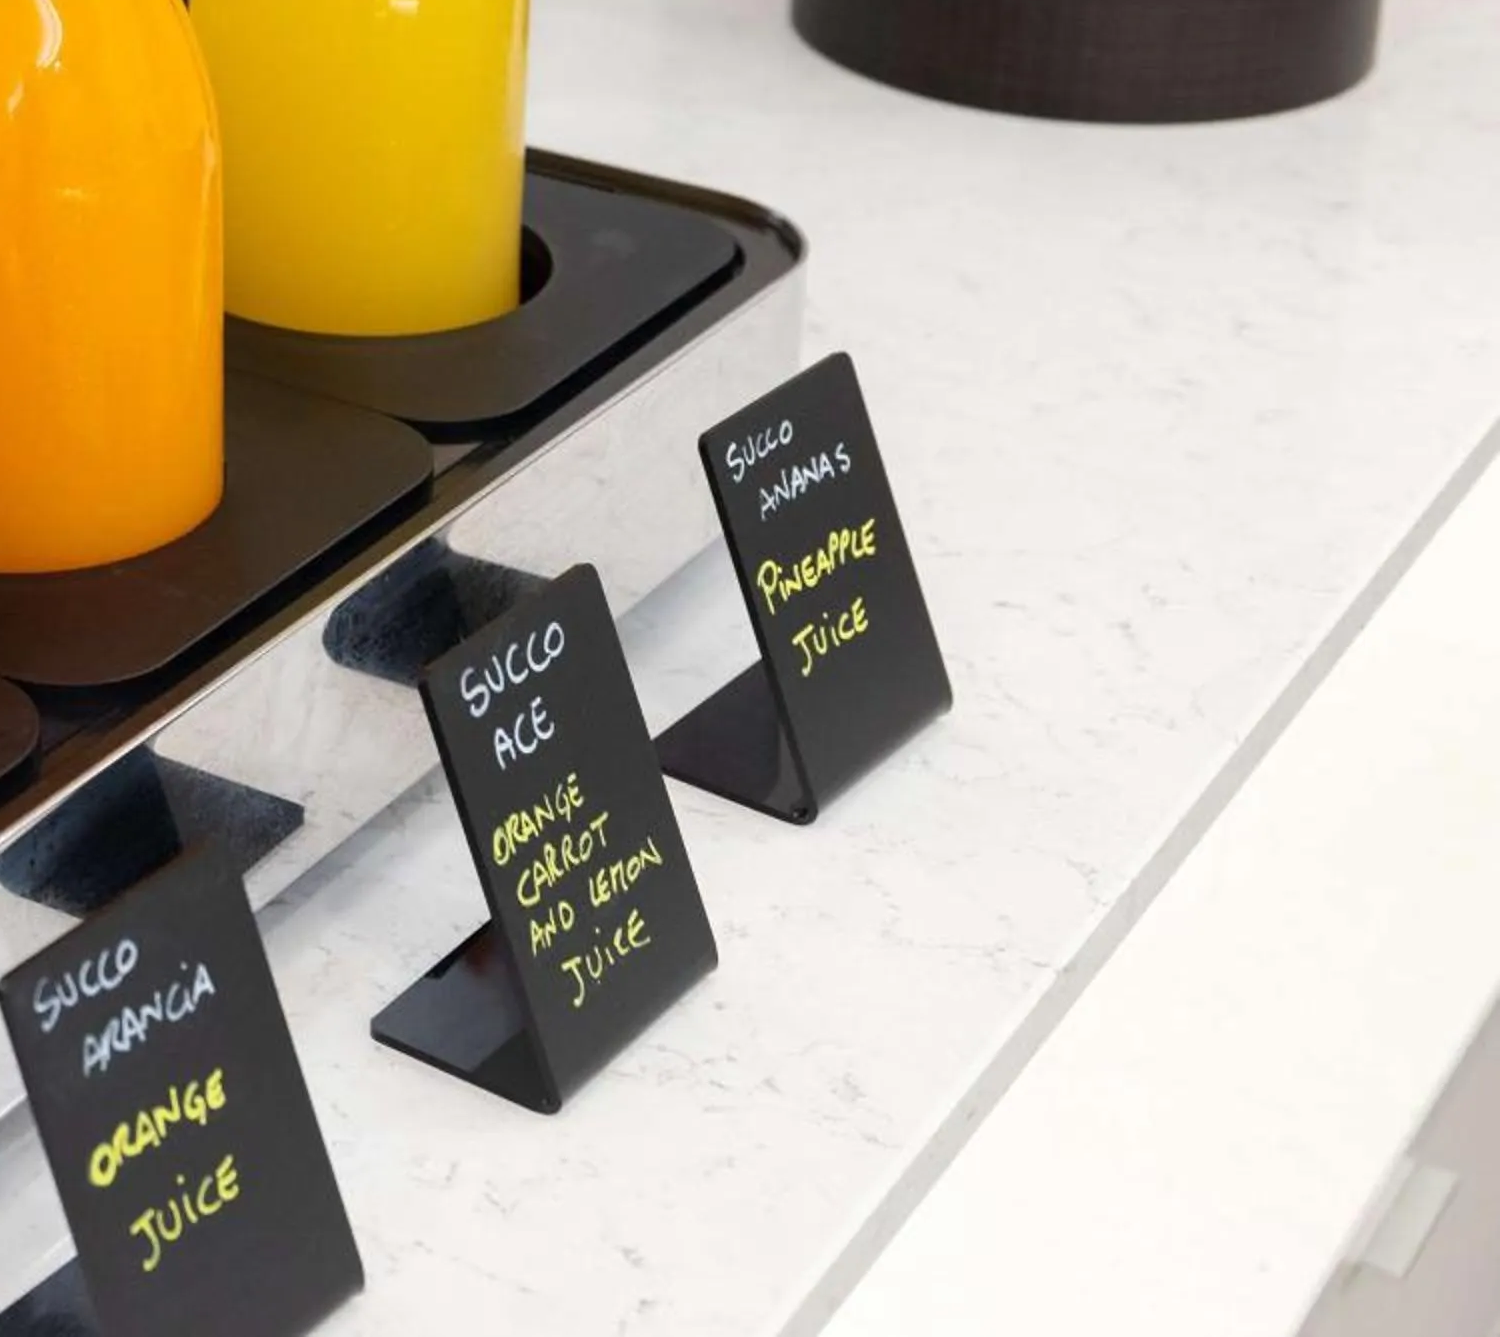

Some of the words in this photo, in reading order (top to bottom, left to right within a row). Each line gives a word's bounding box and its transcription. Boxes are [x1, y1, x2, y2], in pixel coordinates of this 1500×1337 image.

[725, 419, 793, 483] SUCCO
[760, 442, 851, 520] ANANAS
[460, 621, 565, 718] SUCCO
[493, 696, 555, 770] ACE
[492, 772, 584, 866] ORANGE
[516, 811, 609, 907] CARROT
[530, 900, 575, 956] AND
[589, 837, 663, 908] LEMON
[33, 939, 138, 1032] SUCCO
[89, 1069, 226, 1187] ORANGE
